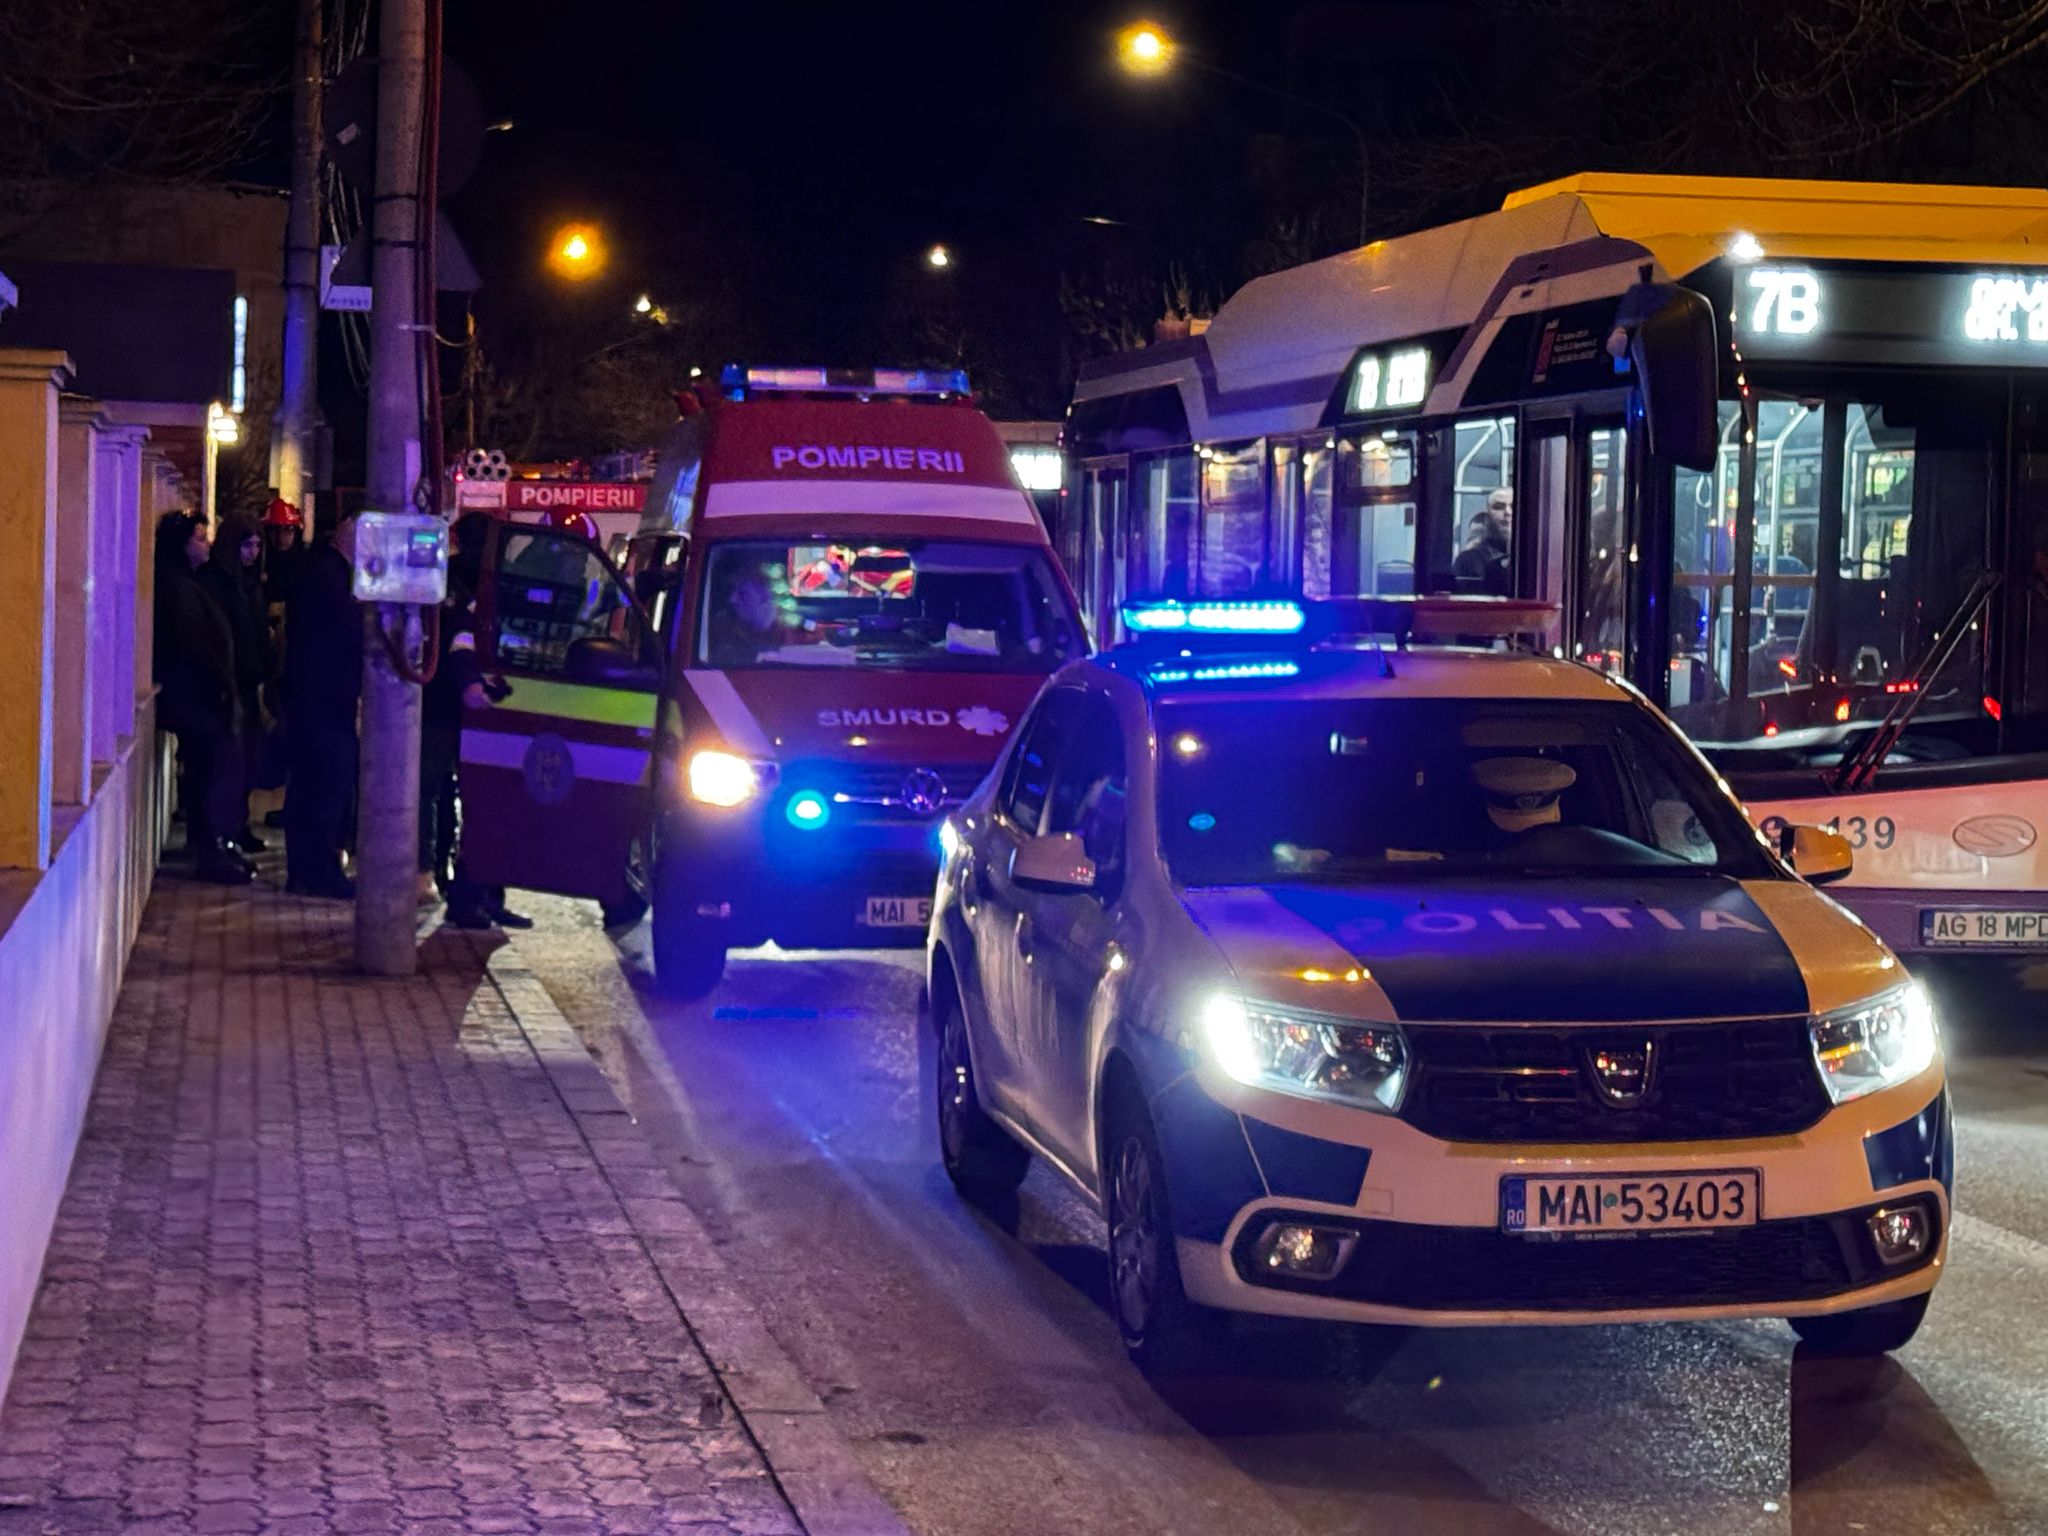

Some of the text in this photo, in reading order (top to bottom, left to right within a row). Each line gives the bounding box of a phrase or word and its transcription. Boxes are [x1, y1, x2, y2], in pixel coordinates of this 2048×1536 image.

[1749, 270, 1819, 333] 7B
[771, 445, 965, 473] POMPIERII
[521, 486, 635, 506] POMPIERII
[818, 708, 950, 726] SMURD
[870, 902, 905, 922] MAI
[1937, 914, 1967, 937] AG
[1976, 915, 1997, 937] 18
[1539, 1180, 1745, 1226] MAI 53403
[1507, 1209, 1525, 1227] RO
